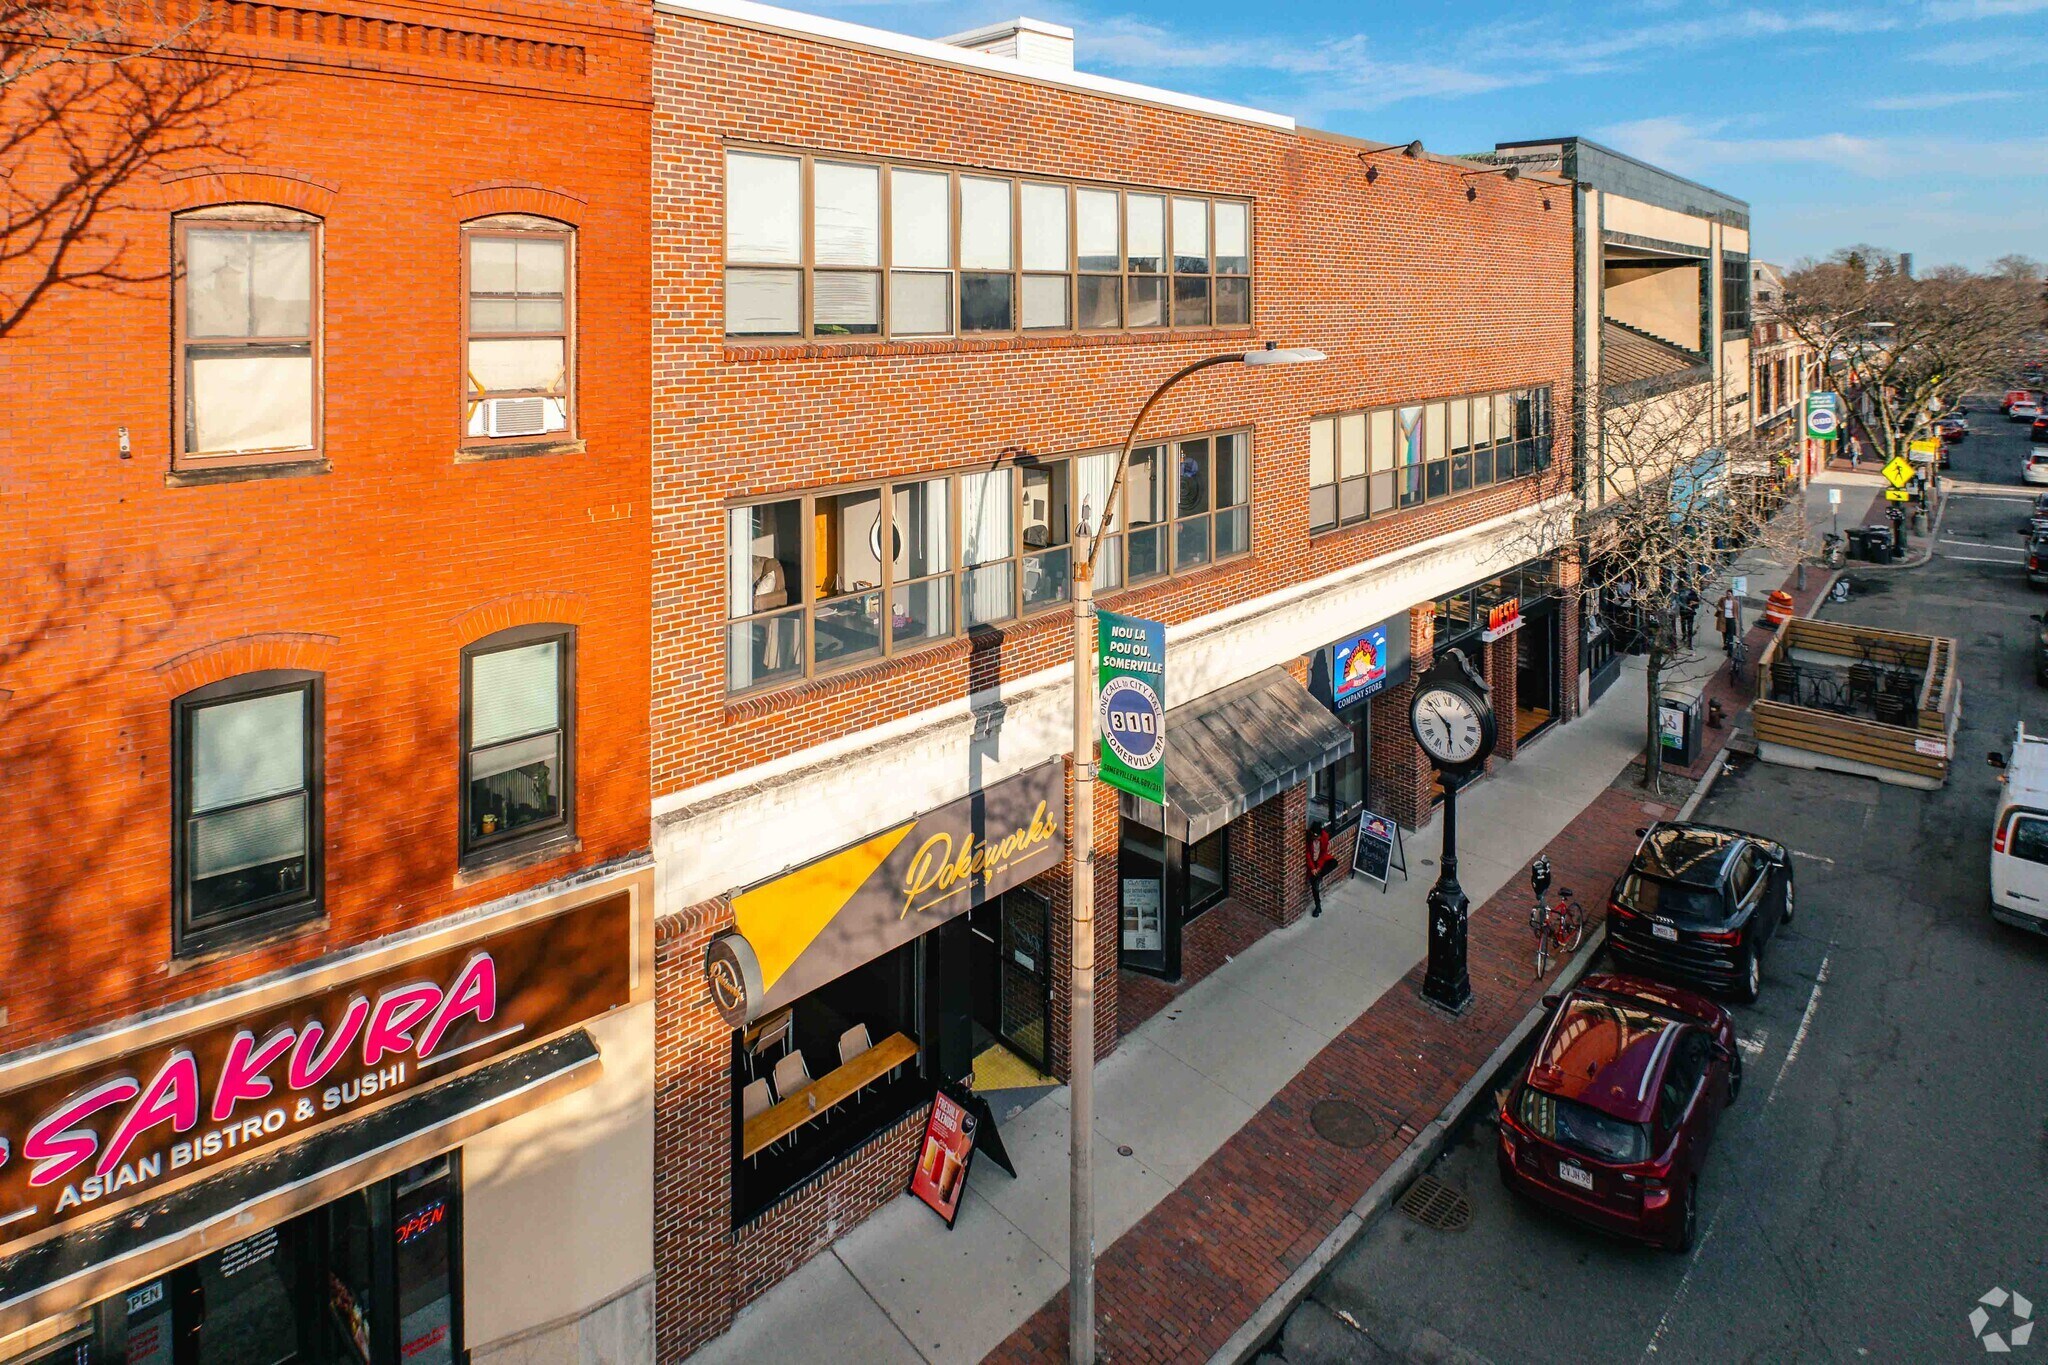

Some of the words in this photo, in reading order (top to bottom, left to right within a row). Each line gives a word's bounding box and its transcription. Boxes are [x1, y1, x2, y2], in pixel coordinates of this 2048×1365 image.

[1111, 626, 1133, 639] NOU
[1134, 628, 1147, 641] LA
[1110, 641, 1132, 654] POU
[1103, 655, 1163, 675] SOMERVILLE
[1100, 694, 1109, 716] ONE
[1106, 680, 1122, 698] CALL
[1129, 680, 1148, 696] CITY
[1148, 692, 1163, 718] HALL
[1337, 690, 1365, 709] COMPANY
[1365, 680, 1383, 697] STORE
[1114, 714, 1152, 732] 311
[1155, 735, 1164, 754] MA
[24, 951, 497, 1187] SAKURA
[934, 1107, 958, 1133] BLENDED
[938, 1096, 961, 1121] FRESHLY
[54, 1152, 161, 1214] ASIAN
[170, 1107, 287, 1174] BISTRO
[295, 1097, 316, 1122] &
[321, 1062, 406, 1112] SUSHI
